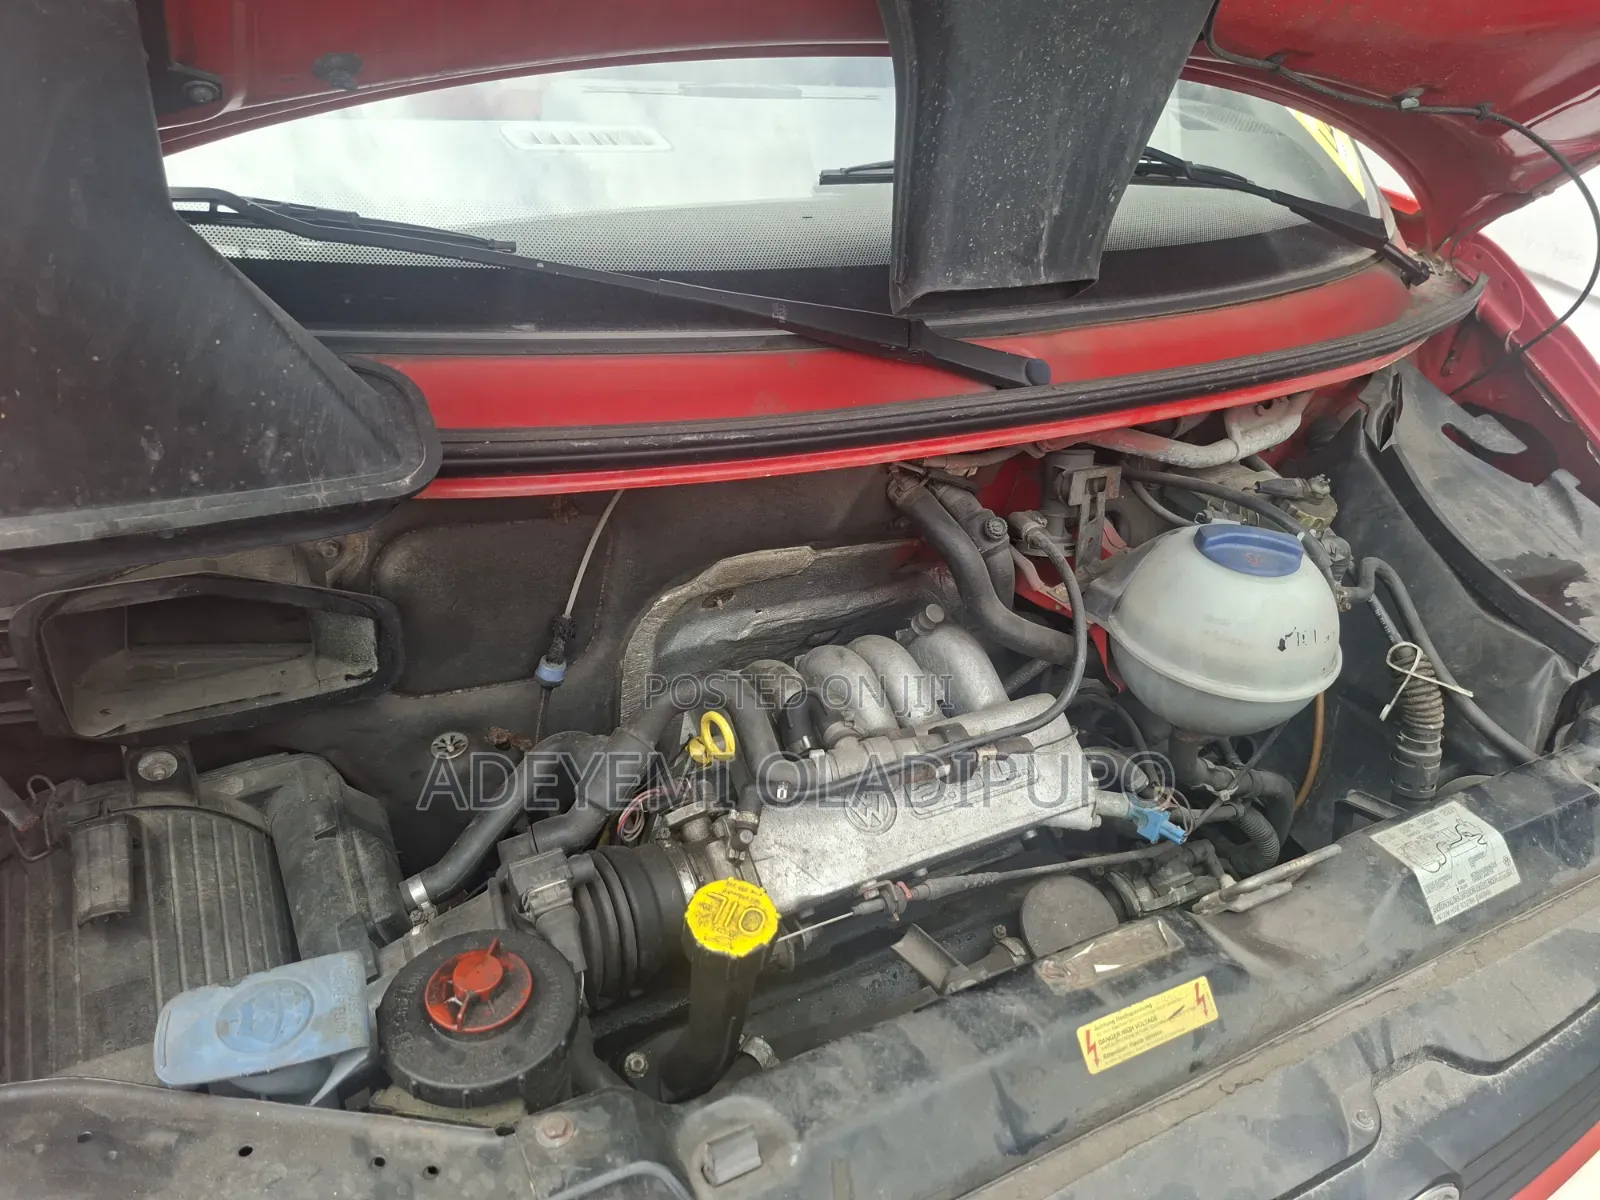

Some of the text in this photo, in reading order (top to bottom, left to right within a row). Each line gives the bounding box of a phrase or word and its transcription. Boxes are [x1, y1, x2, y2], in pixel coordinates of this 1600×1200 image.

[1098, 1031, 1121, 1045] DANGER
[1120, 1025, 1135, 1036] HIGH
[1134, 1015, 1158, 1030] VOLTAGE
